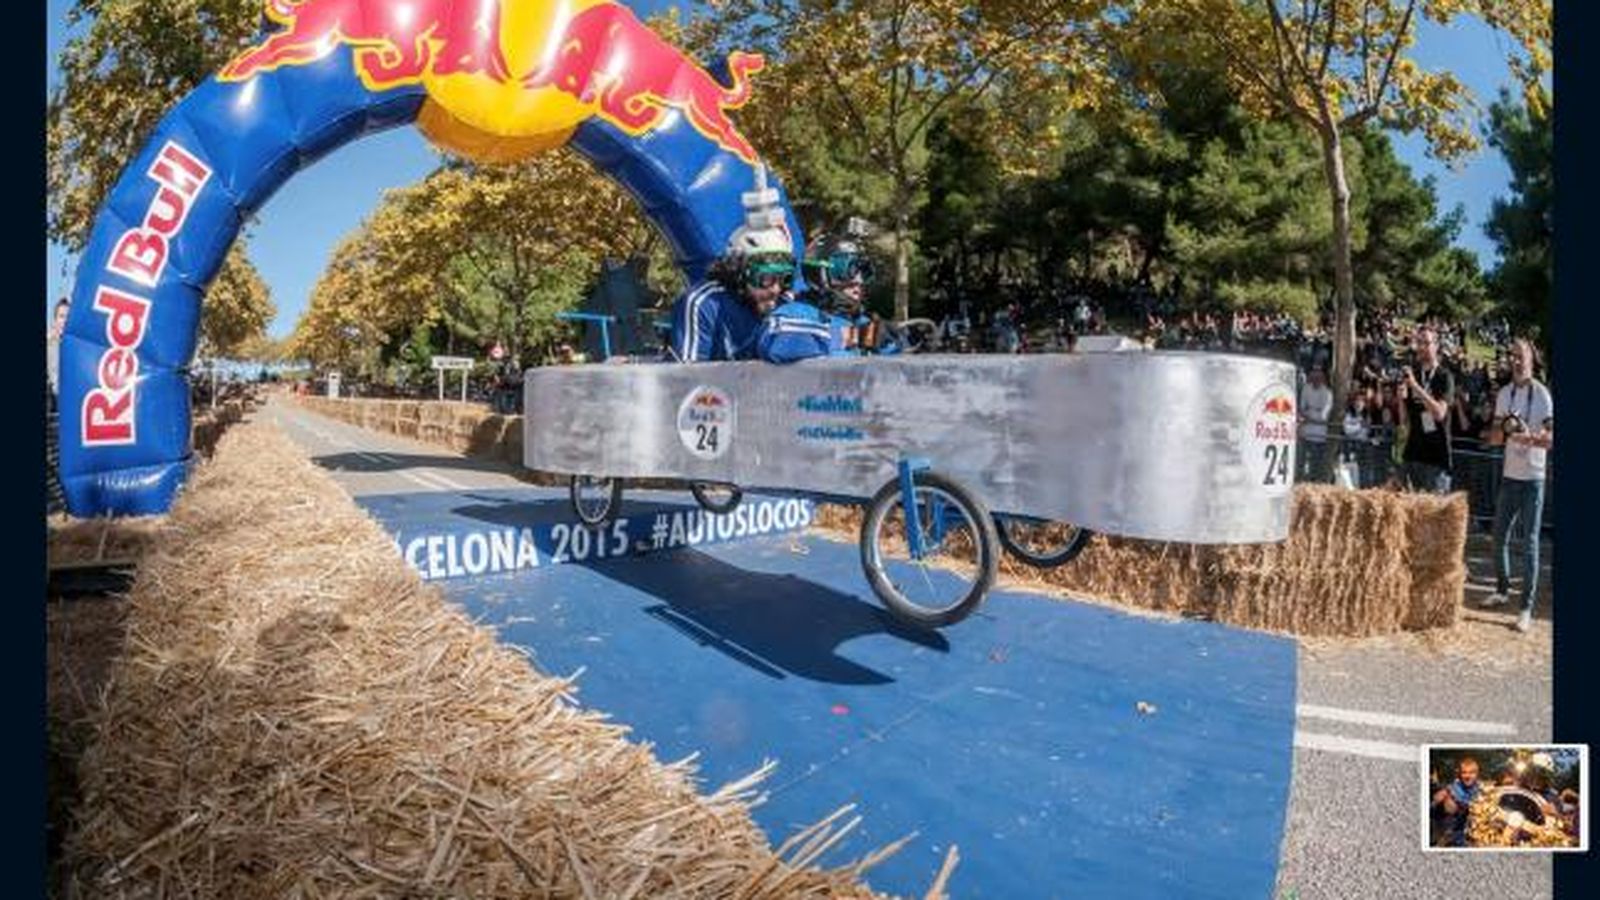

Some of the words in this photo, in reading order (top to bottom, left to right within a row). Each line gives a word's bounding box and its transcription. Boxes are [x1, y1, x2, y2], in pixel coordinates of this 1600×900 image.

[106, 140, 213, 288] Bull
[83, 286, 151, 445] Red
[696, 424, 718, 452] 24
[1263, 445, 1289, 485] 24
[551, 519, 629, 563] 2015
